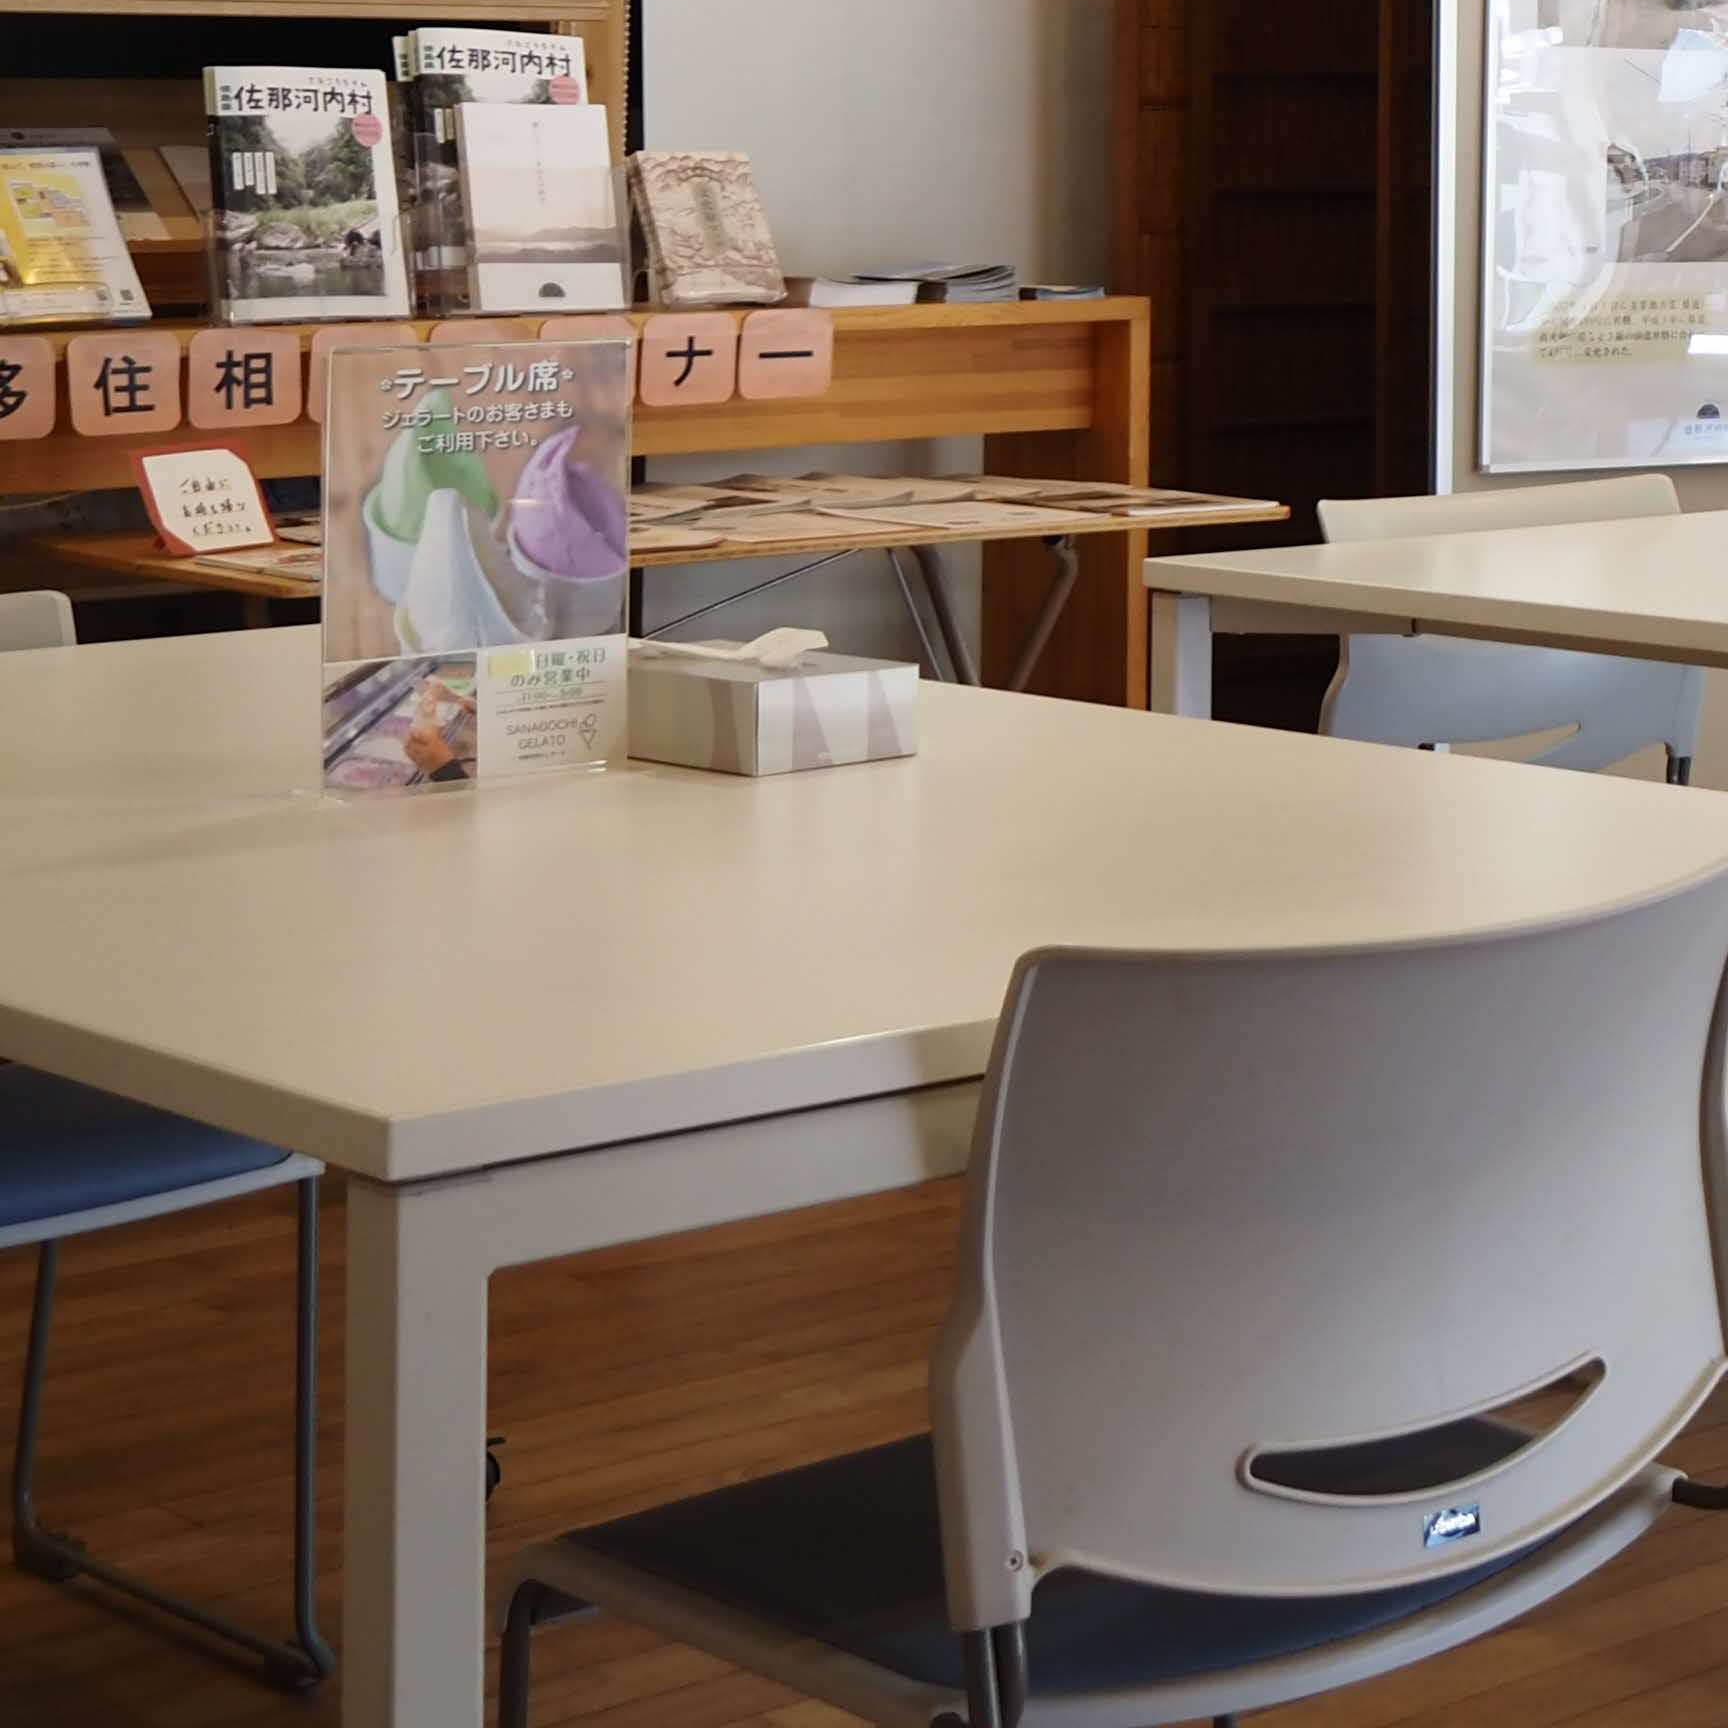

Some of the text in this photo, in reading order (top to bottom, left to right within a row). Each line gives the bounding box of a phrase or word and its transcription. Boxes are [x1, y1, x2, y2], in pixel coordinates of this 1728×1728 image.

[436, 44, 572, 78] 佐那河内村
[234, 84, 372, 114] 佐那河内村
[394, 360, 561, 400] テーブル席
[382, 402, 573, 430] ジェラートのお客さまも
[416, 431, 540, 455] ご利用下さい。
